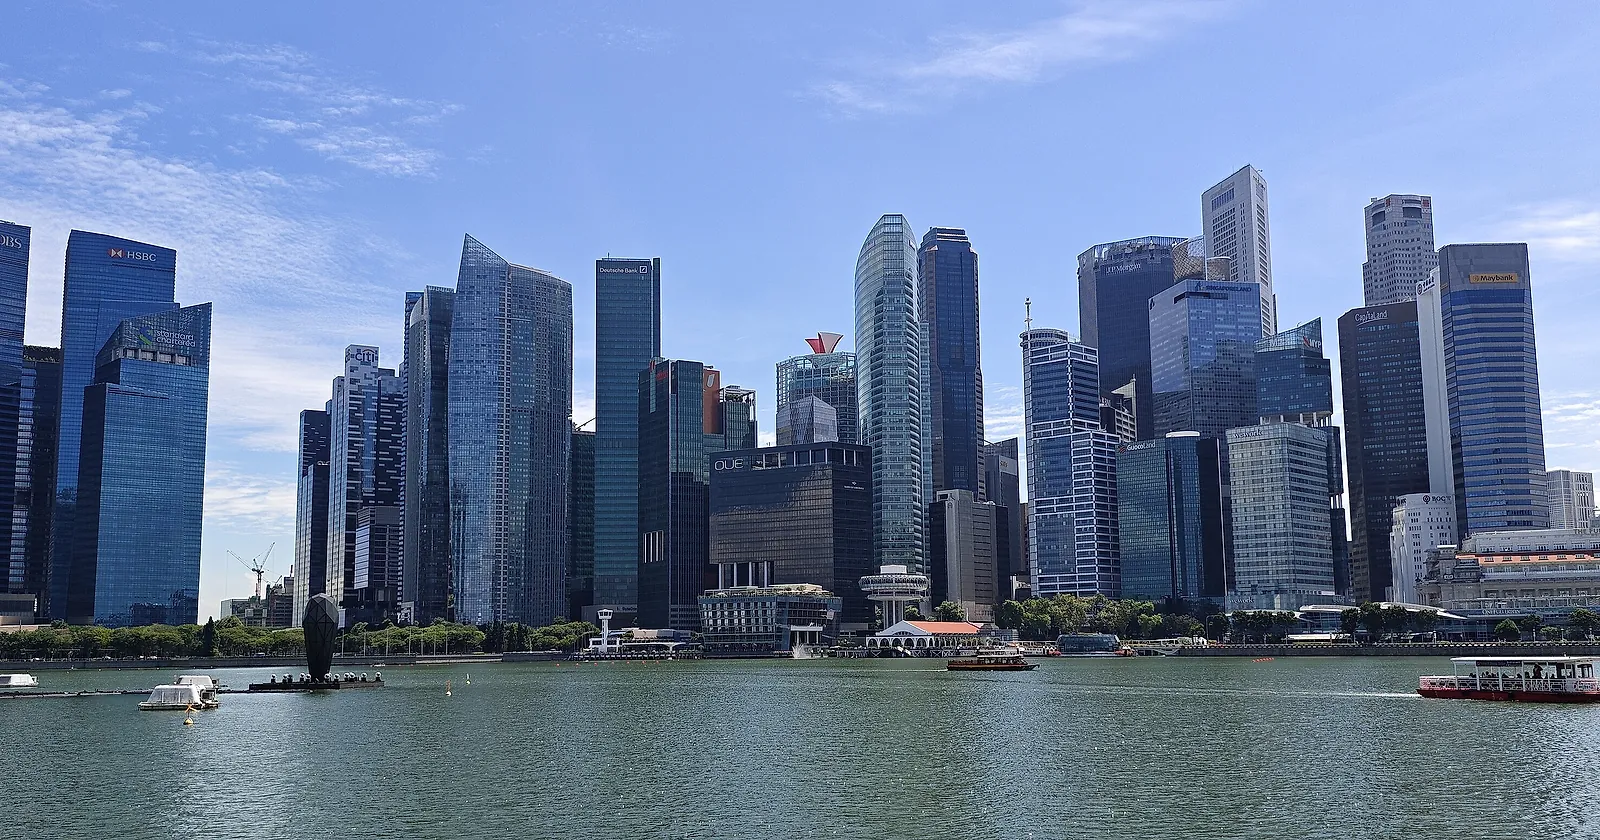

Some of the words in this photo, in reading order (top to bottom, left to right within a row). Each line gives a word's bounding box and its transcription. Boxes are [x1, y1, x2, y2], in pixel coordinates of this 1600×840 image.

[127, 251, 157, 262] HSBC
[1480, 274, 1514, 282] Maybank
[1354, 310, 1388, 323] CapitaLand
[156, 329, 194, 341] standard
[156, 337, 196, 348] chartered
[1309, 338, 1321, 349] MYP
[355, 350, 375, 363] citi
[714, 459, 744, 471] OUE
